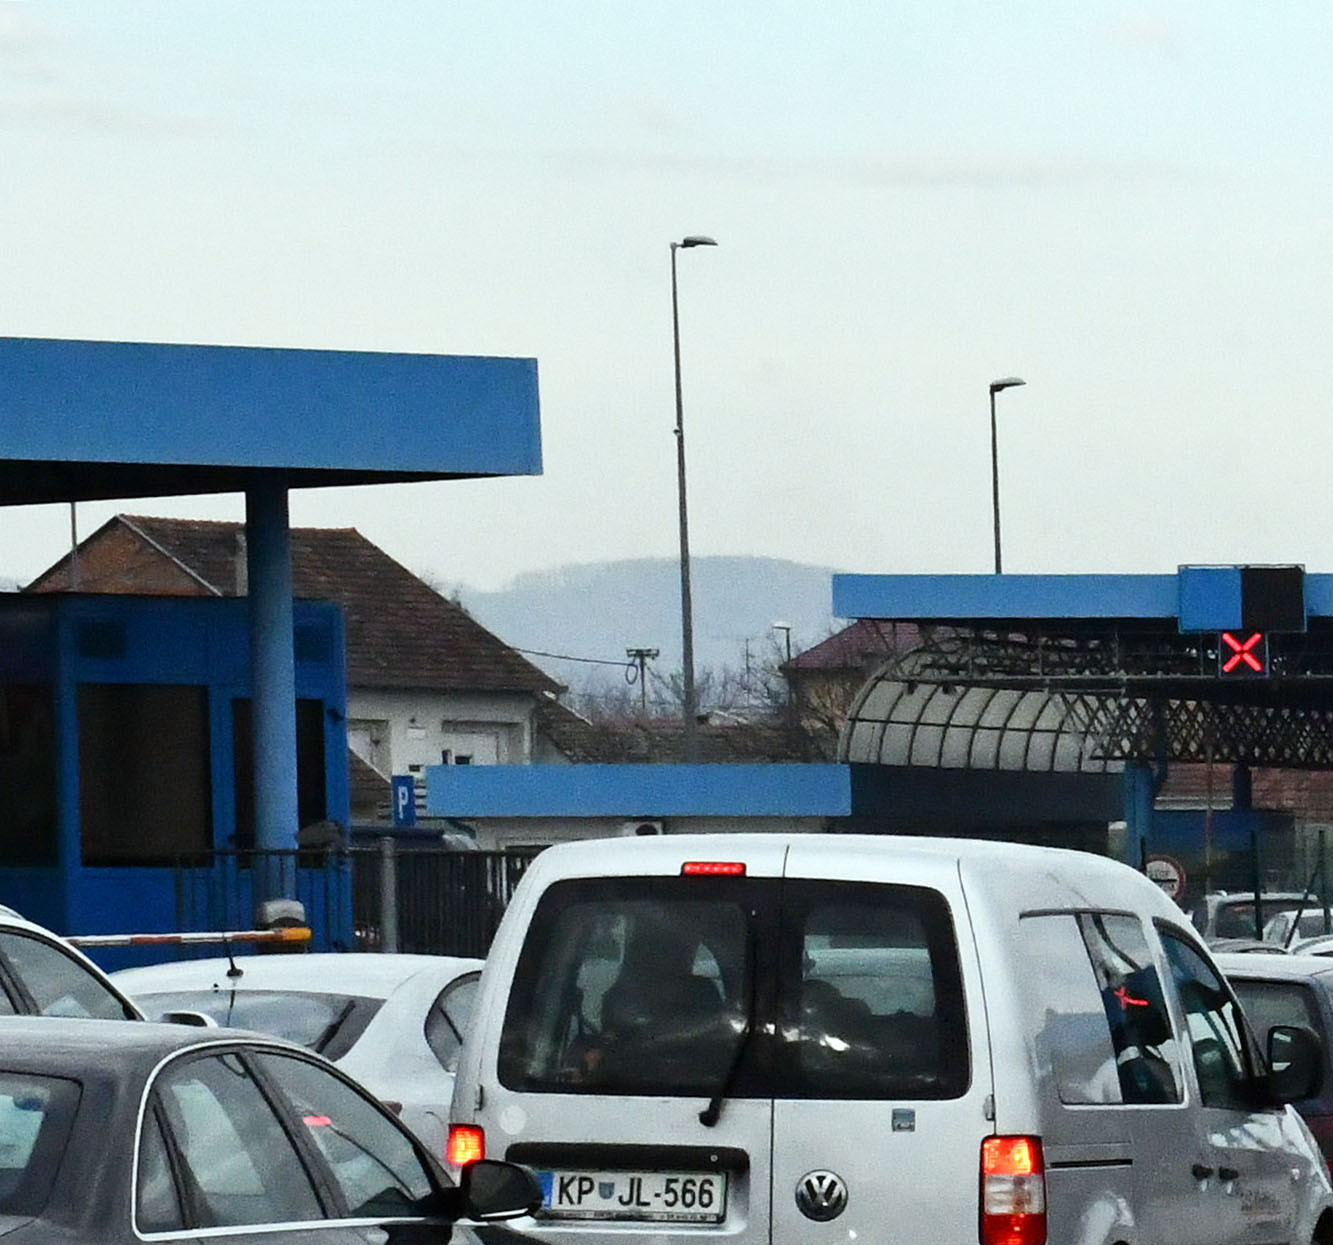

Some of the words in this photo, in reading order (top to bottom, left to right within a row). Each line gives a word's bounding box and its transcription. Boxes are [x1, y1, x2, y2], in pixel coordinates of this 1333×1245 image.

[398, 786, 409, 819] P
[558, 1175, 595, 1206] KP
[617, 1177, 715, 1209] JL-566
